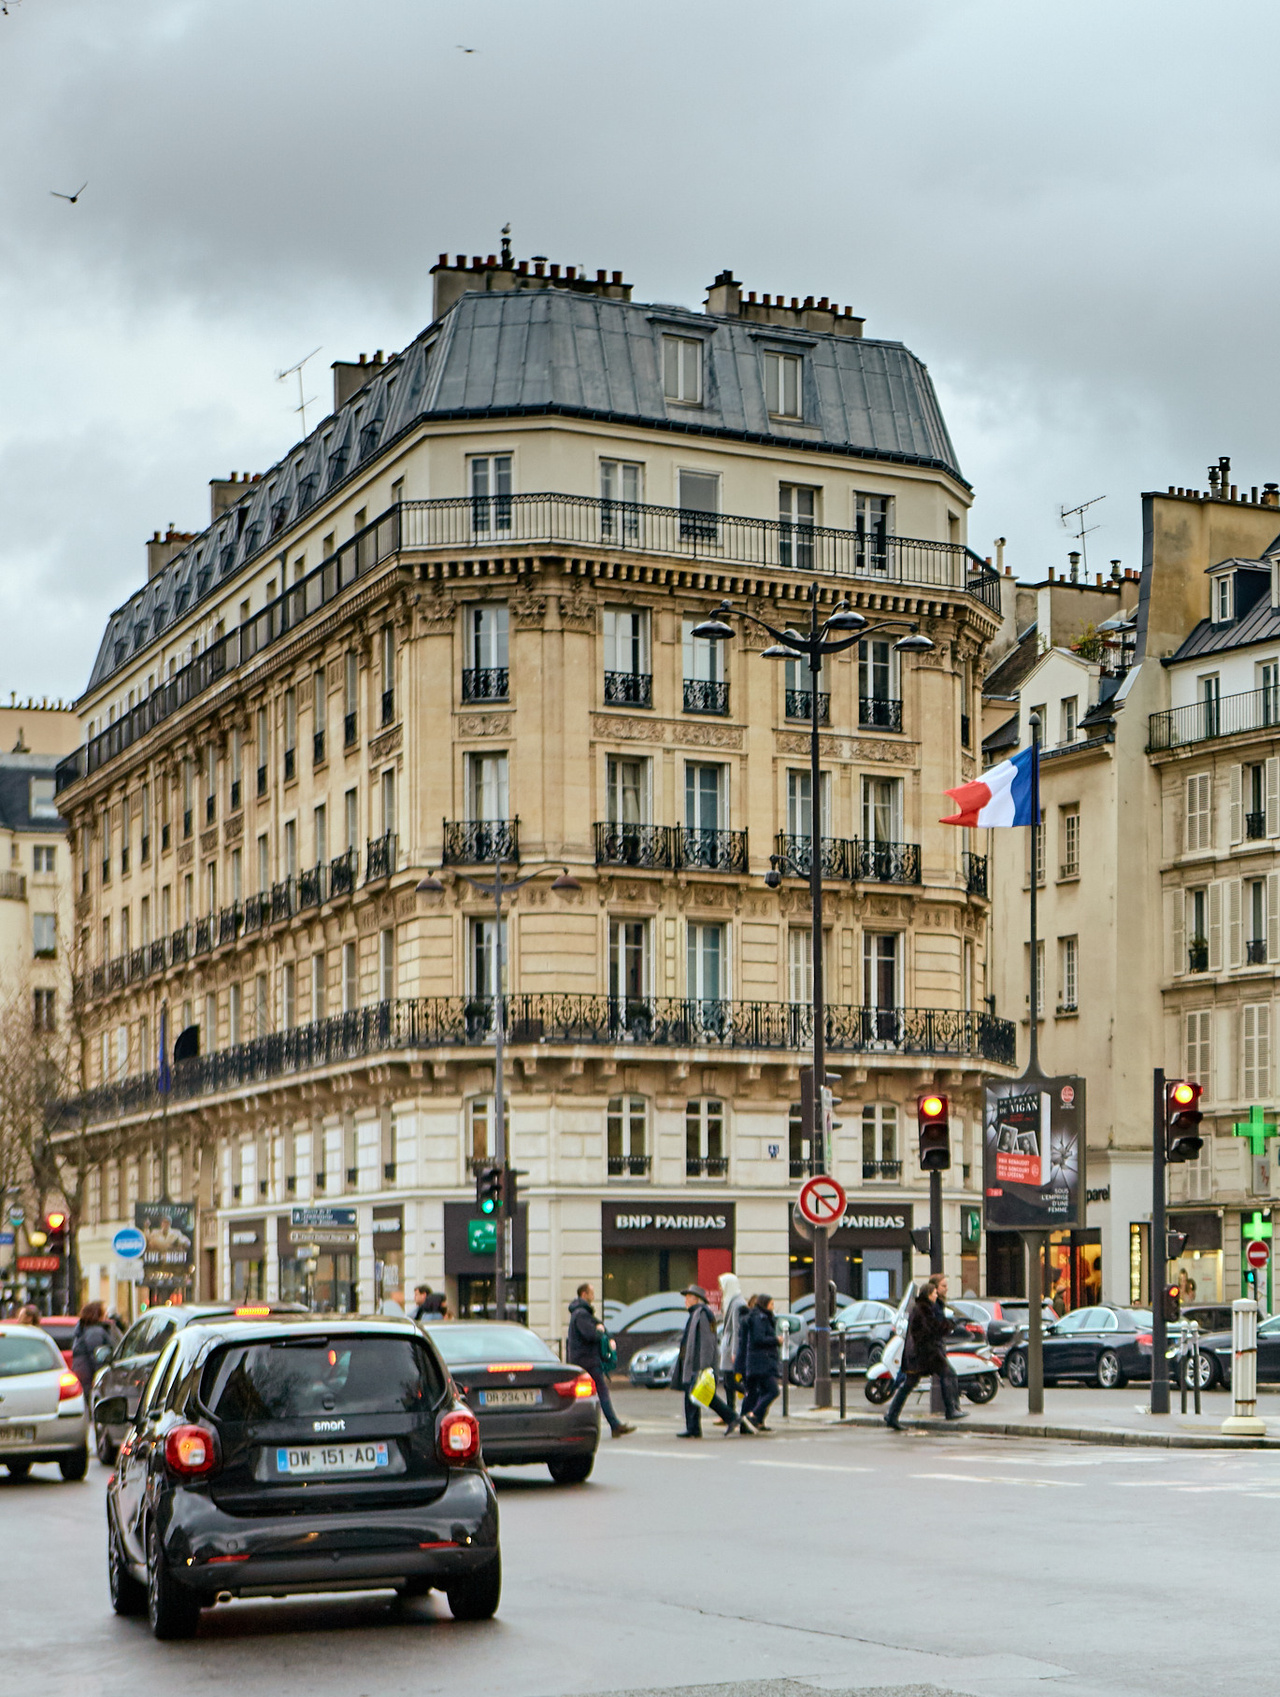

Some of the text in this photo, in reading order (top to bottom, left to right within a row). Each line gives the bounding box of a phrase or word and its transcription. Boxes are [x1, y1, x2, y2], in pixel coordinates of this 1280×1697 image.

[1010, 1101, 1038, 1113] VIGAN
[616, 1215, 726, 1229] BNP PARIBAS
[839, 1215, 904, 1228] PARIBAS
[166, 1252, 187, 1263] NIGHT
[313, 1419, 346, 1432] smart
